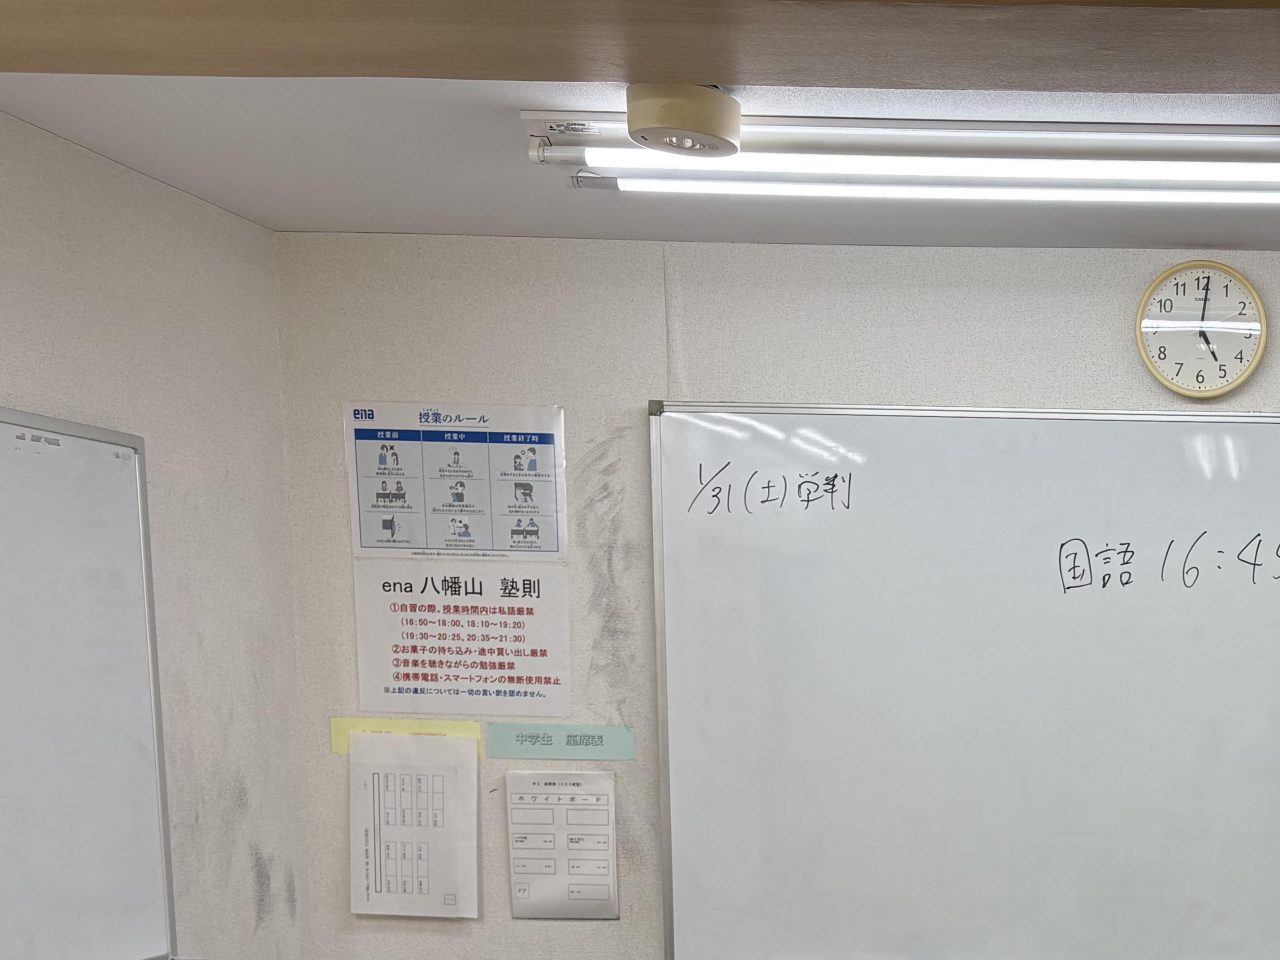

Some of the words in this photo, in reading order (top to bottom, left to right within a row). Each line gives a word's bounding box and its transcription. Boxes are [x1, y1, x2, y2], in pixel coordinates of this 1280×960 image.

[1174, 282, 1186, 296] 11
[1195, 276, 1210, 291] 12
[1223, 284, 1229, 298] 1
[1157, 298, 1173, 313] 10
[1238, 301, 1247, 316] 2
[1158, 346, 1167, 361] 8
[1234, 349, 1244, 364] 4
[1174, 362, 1184, 377] 7
[1196, 369, 1205, 384] 6
[1218, 364, 1227, 379] 5
[353, 408, 375, 421] ena
[418, 411, 490, 425] 授業のルール
[444, 433, 466, 441] 授業中
[1059, 538, 1135, 593] 国語
[382, 581, 413, 594] ena
[420, 576, 483, 597] 八幡山
[500, 578, 541, 599] 塾則
[513, 732, 553, 746] 中学生
[565, 734, 604, 747] 座席表
